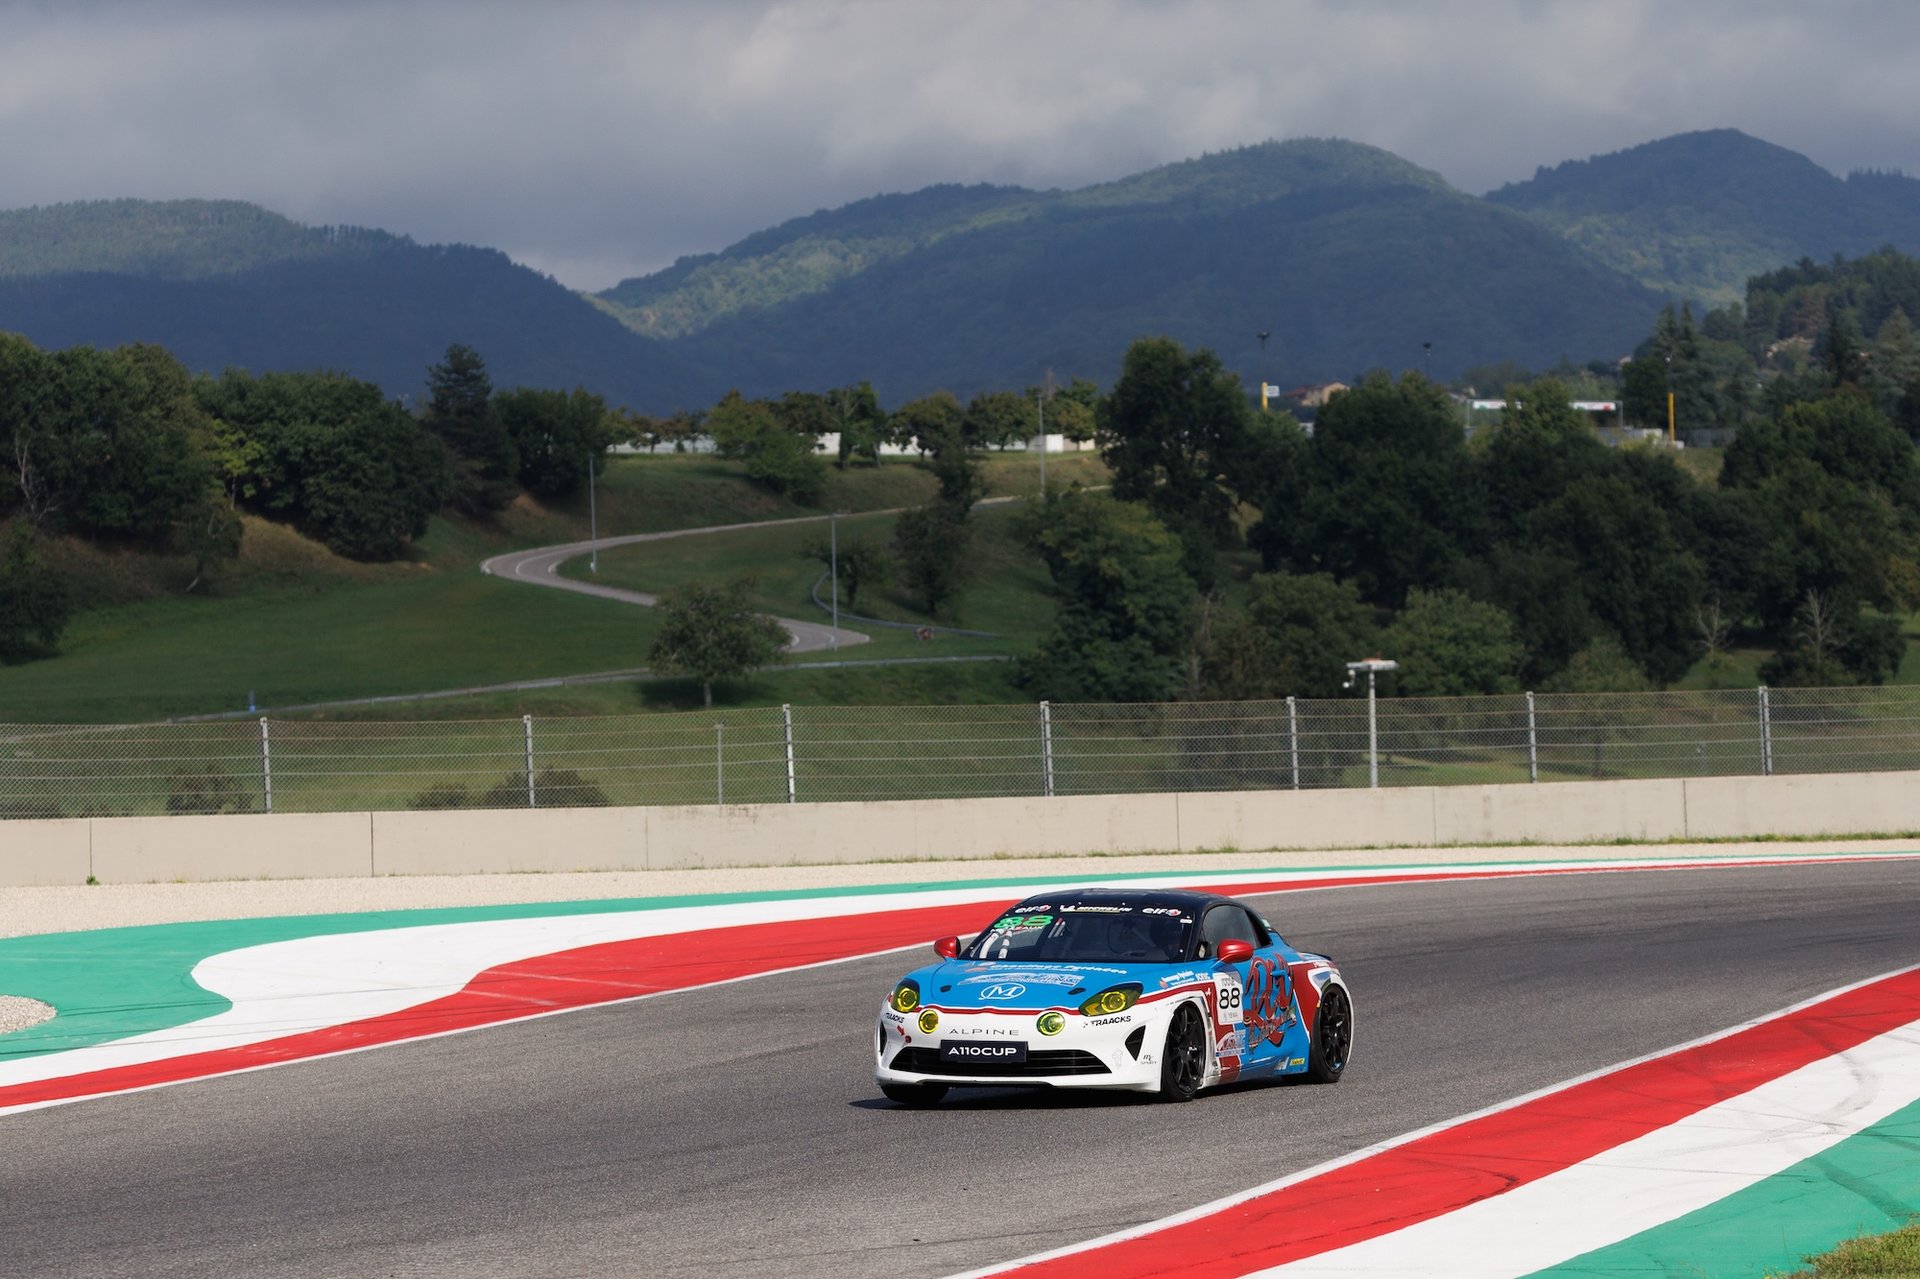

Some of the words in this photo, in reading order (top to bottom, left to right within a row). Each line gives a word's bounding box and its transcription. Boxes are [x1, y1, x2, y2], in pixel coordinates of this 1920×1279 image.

[994, 915, 1053, 928] 88
[1219, 987, 1240, 1010] 88
[1091, 1015, 1132, 1026] TRAACKS
[949, 1028, 1020, 1036] ALPINE
[948, 1047, 1017, 1056] A110CUP
